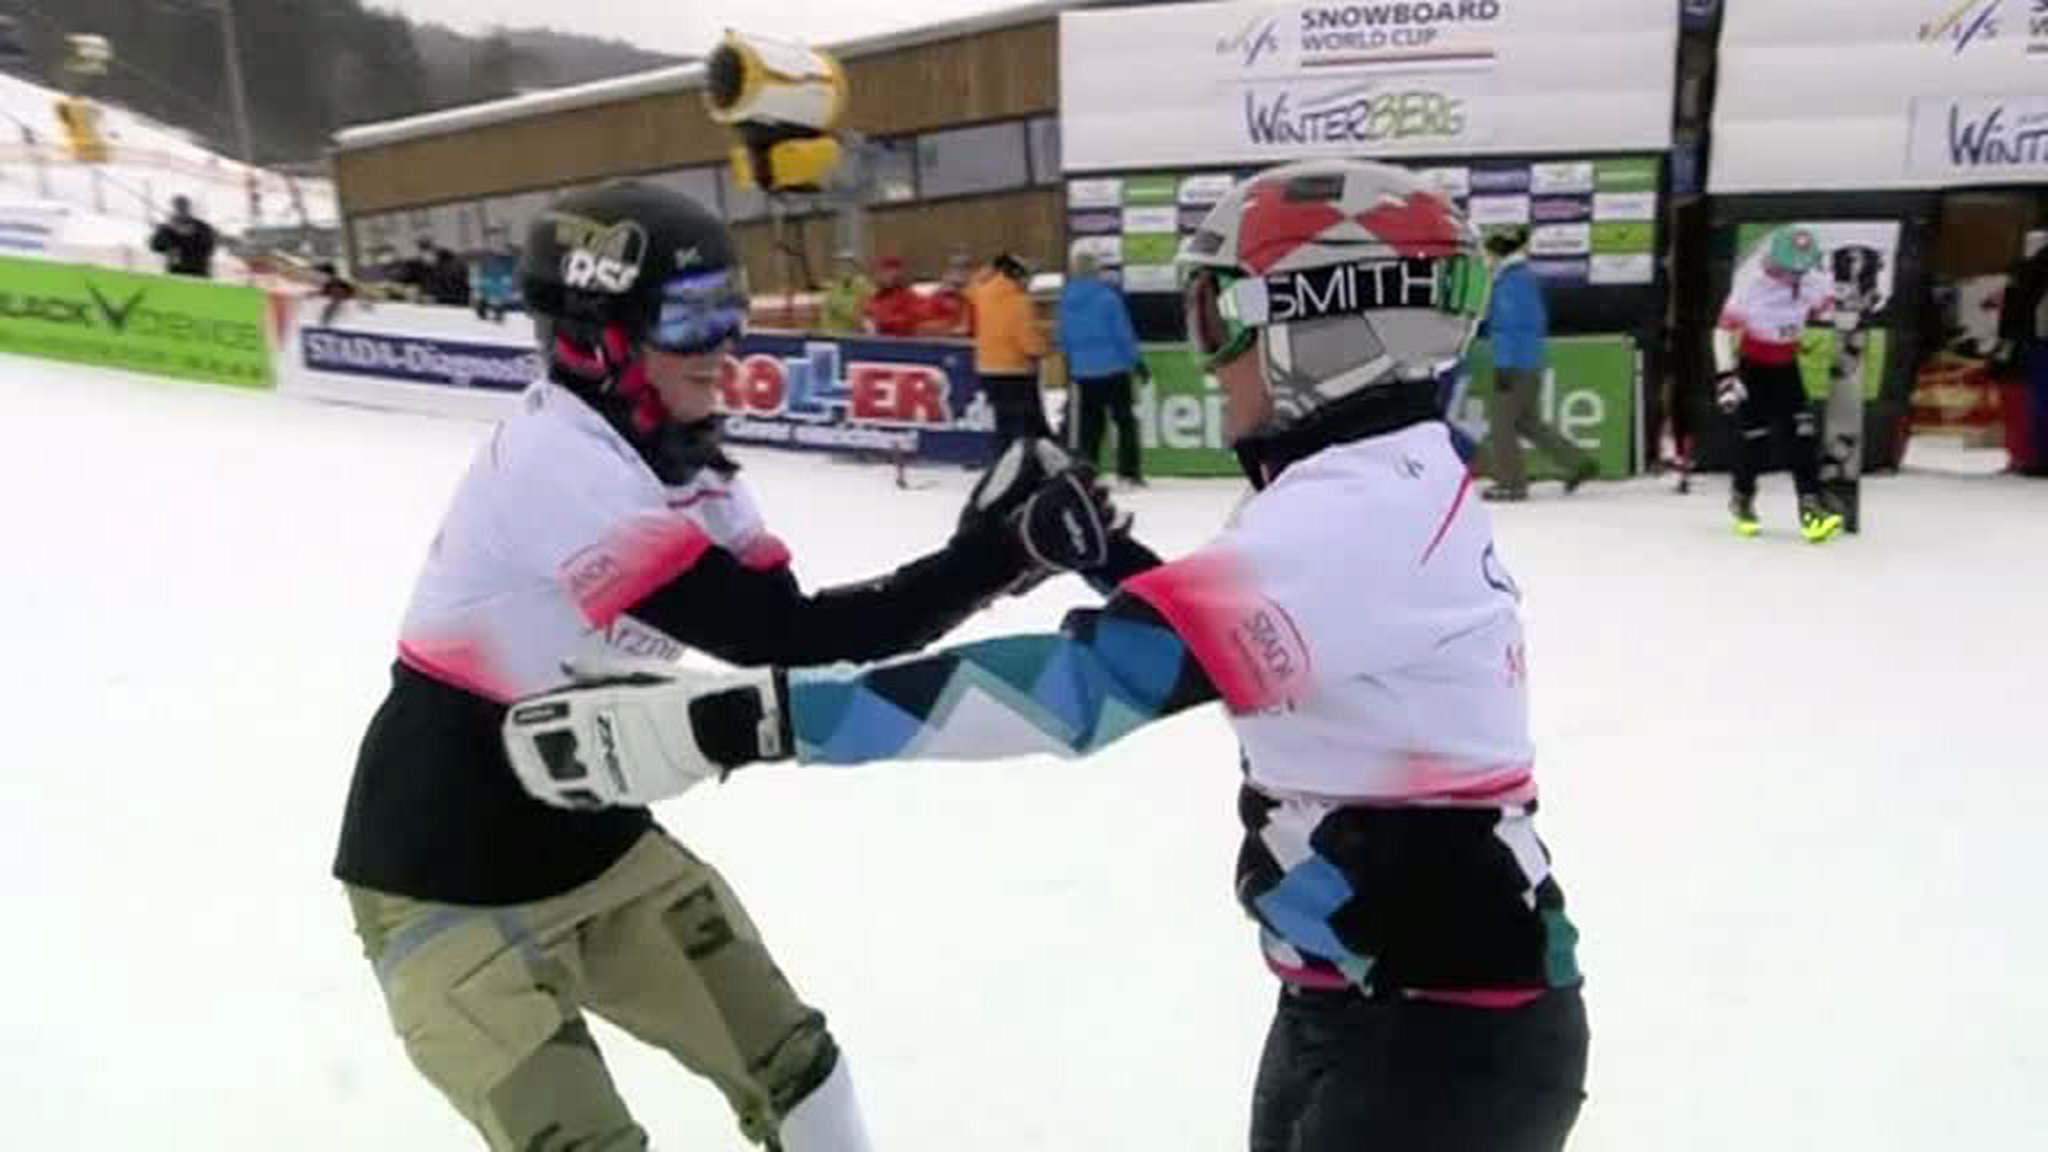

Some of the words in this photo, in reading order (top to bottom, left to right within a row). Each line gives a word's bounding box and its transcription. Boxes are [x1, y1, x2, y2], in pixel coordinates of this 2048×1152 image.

[1301, 0, 1499, 28] SNOWBOARD
[1302, 32, 1386, 51] WORLD
[1391, 28, 1437, 46] CUP
[1268, 259, 1439, 321] SMITH
